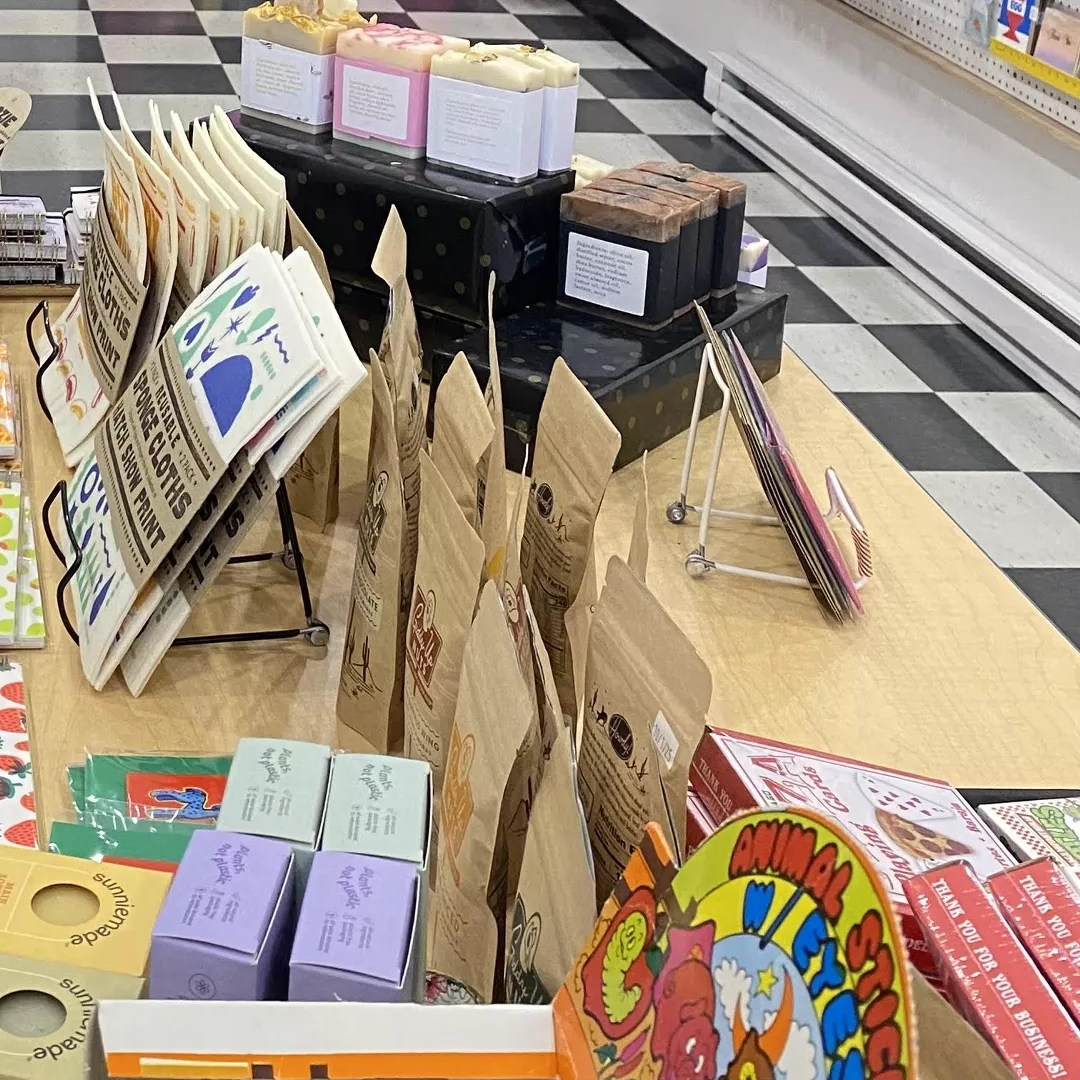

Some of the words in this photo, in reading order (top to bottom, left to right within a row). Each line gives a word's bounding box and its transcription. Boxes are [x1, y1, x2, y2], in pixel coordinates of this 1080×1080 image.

[1010, 2, 1023, 12] EGG
[98, 272, 131, 341] CLOTHS
[97, 325, 120, 369] PRINT
[155, 384, 181, 449] REUSABLE
[133, 369, 160, 441] SPONGE
[148, 431, 192, 520] CLOTHS
[112, 400, 130, 450] HATCH
[121, 443, 143, 494] SHOW
[134, 487, 166, 549] PRINT
[261, 758, 281, 784] plastic
[359, 774, 383, 802] plastic
[699, 758, 722, 791] THANK
[719, 788, 733, 810] YOU
[802, 765, 850, 813] Cards
[599, 805, 626, 849] Nutrition
[0, 881, 16, 905] MAIN
[209, 857, 233, 886] plastic
[336, 878, 362, 911] plastic
[728, 819, 853, 927] ANIMAL
[70, 872, 136, 947] sunniemade
[1019, 875, 1052, 915] THANK
[1046, 914, 1073, 943] YOU
[932, 878, 965, 918] THANK
[958, 919, 982, 944] YOU
[974, 946, 998, 973] FOR
[991, 972, 1021, 1010] YOUR
[1013, 1009, 1069, 1080] BUSINESS!
